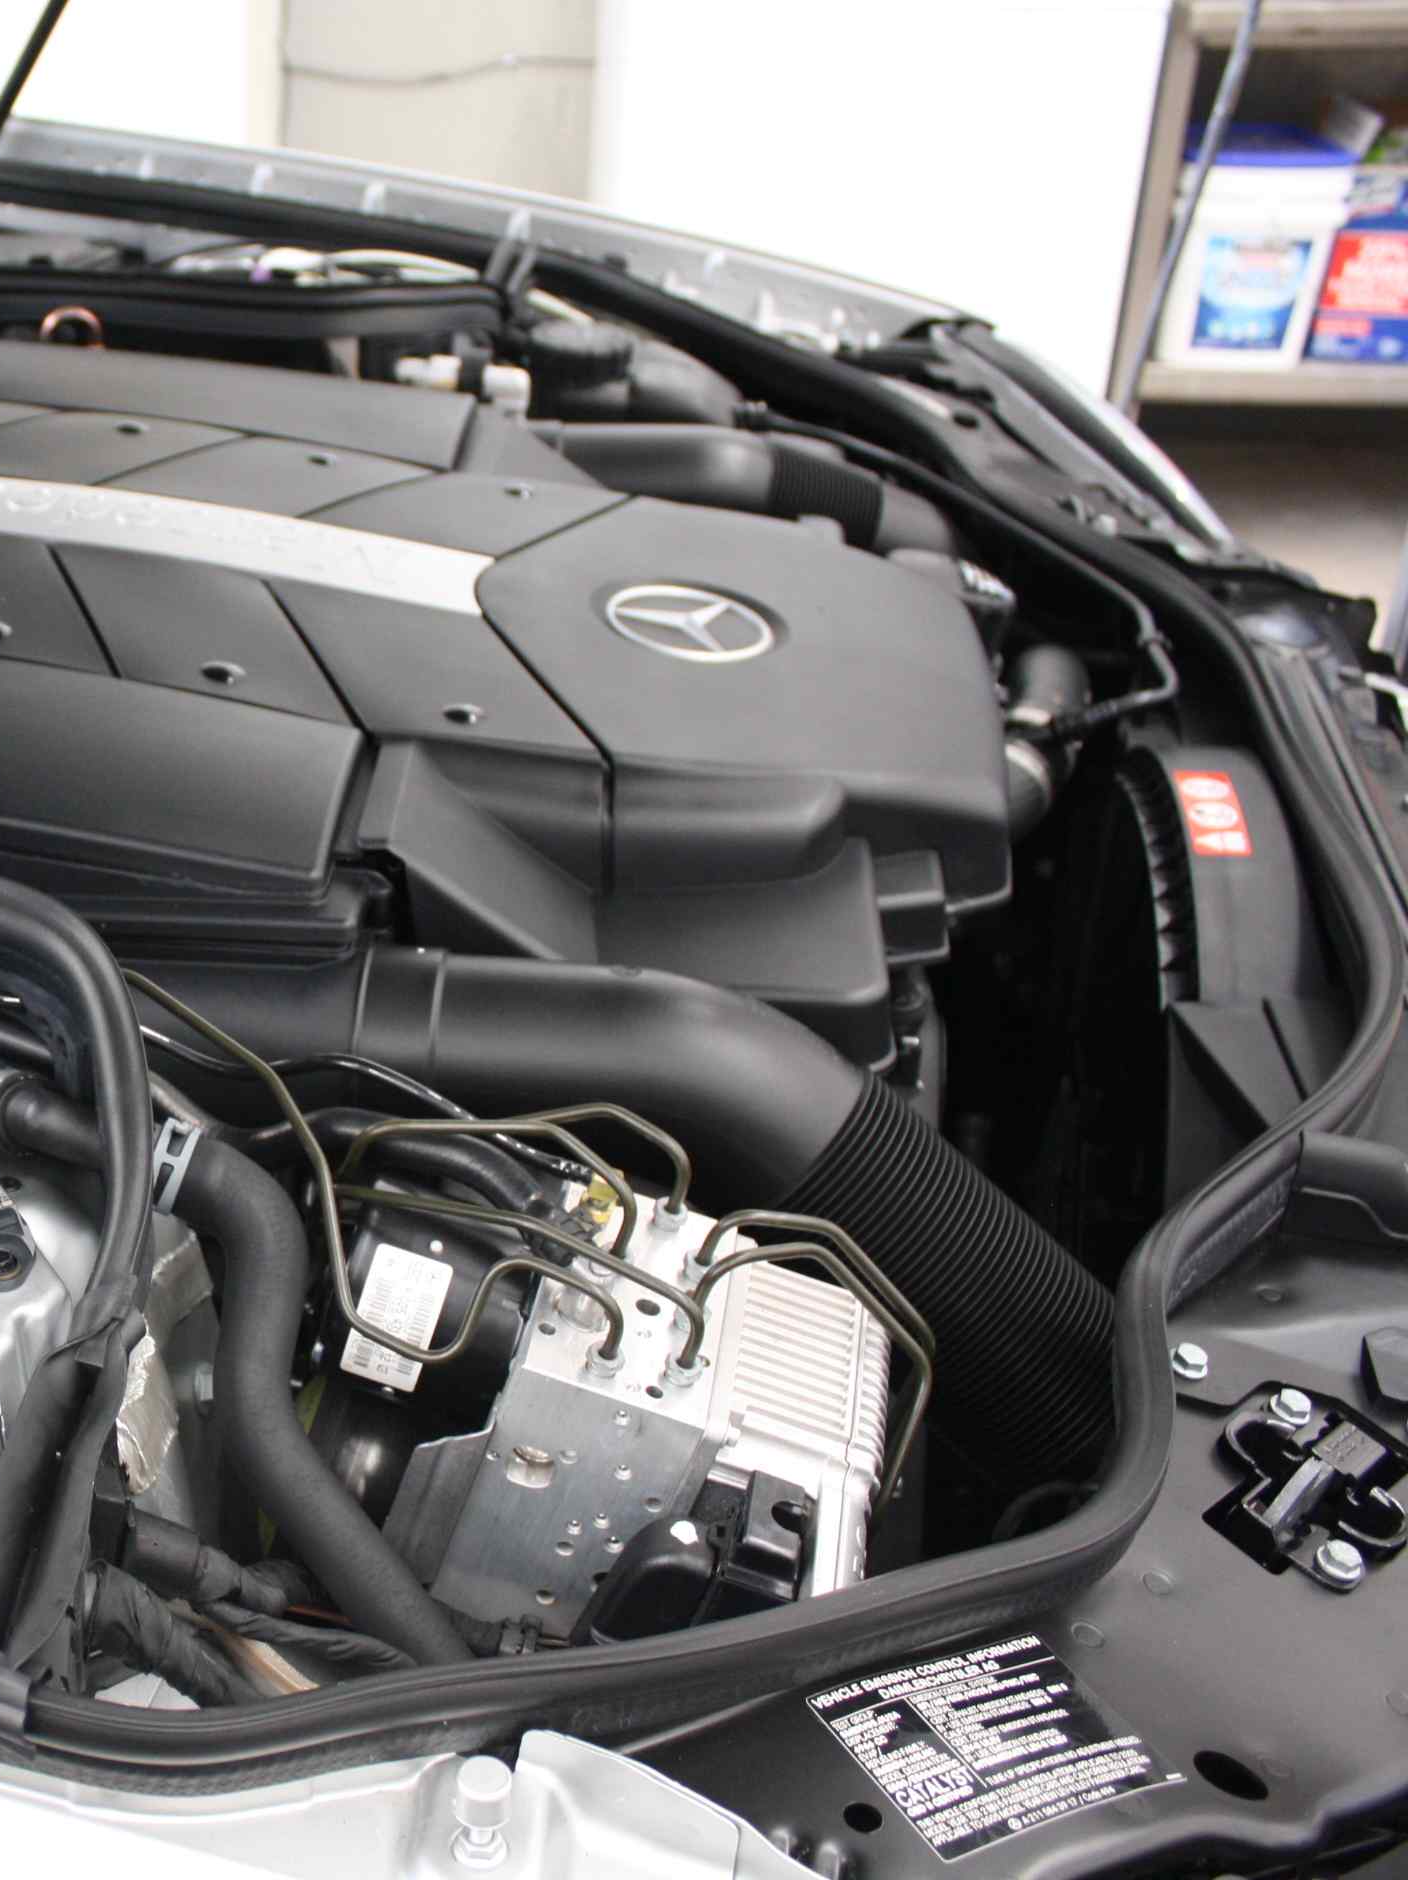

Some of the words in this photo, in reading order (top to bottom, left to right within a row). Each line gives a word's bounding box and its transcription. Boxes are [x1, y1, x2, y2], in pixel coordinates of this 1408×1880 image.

[811, 1685, 863, 1710] VEHICLE
[860, 1668, 917, 1693] EMISSION
[916, 1656, 970, 1677] CONTROL
[970, 1635, 1041, 1664] INFORMATION
[878, 1667, 981, 1700] DAIMLERCHRYSLER
[981, 1660, 1001, 1673] AG
[895, 1766, 973, 1808] CATALYST
